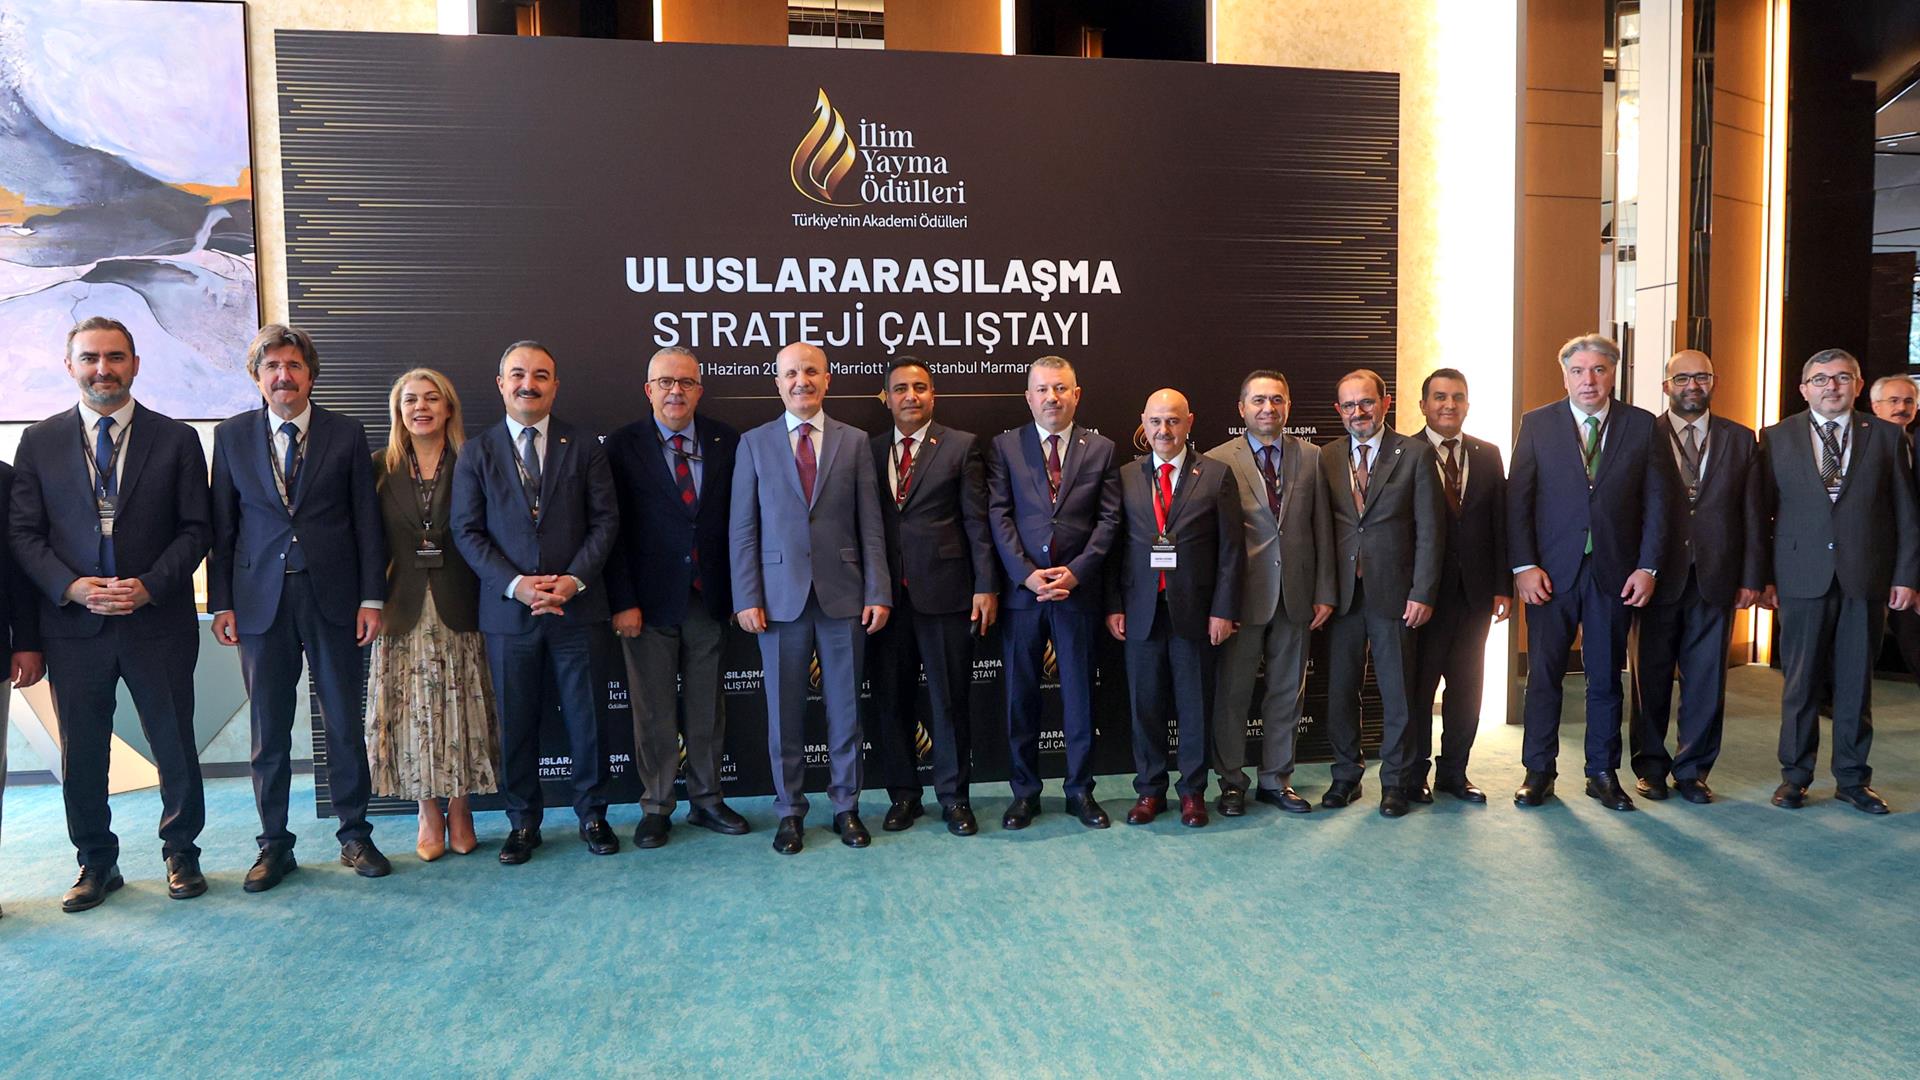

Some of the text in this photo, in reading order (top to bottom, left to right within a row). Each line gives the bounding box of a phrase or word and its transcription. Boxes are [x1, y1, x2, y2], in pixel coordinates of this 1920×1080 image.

[859, 118, 914, 149] İlim
[860, 150, 949, 178] Yayma
[860, 175, 966, 204] Ödülleri
[862, 214, 917, 228] Akademi
[919, 213, 968, 229] Ödülleri
[625, 256, 1122, 301] ULUSLARARASILAŞMA
[653, 302, 1090, 354] STRATEJİ ÇALIŞTAYI
[699, 362, 704, 375] 1
[707, 362, 759, 375] Haziran
[762, 362, 778, 375] 20
[830, 361, 883, 374] Marriott
[980, 361, 1032, 374] Marmar
